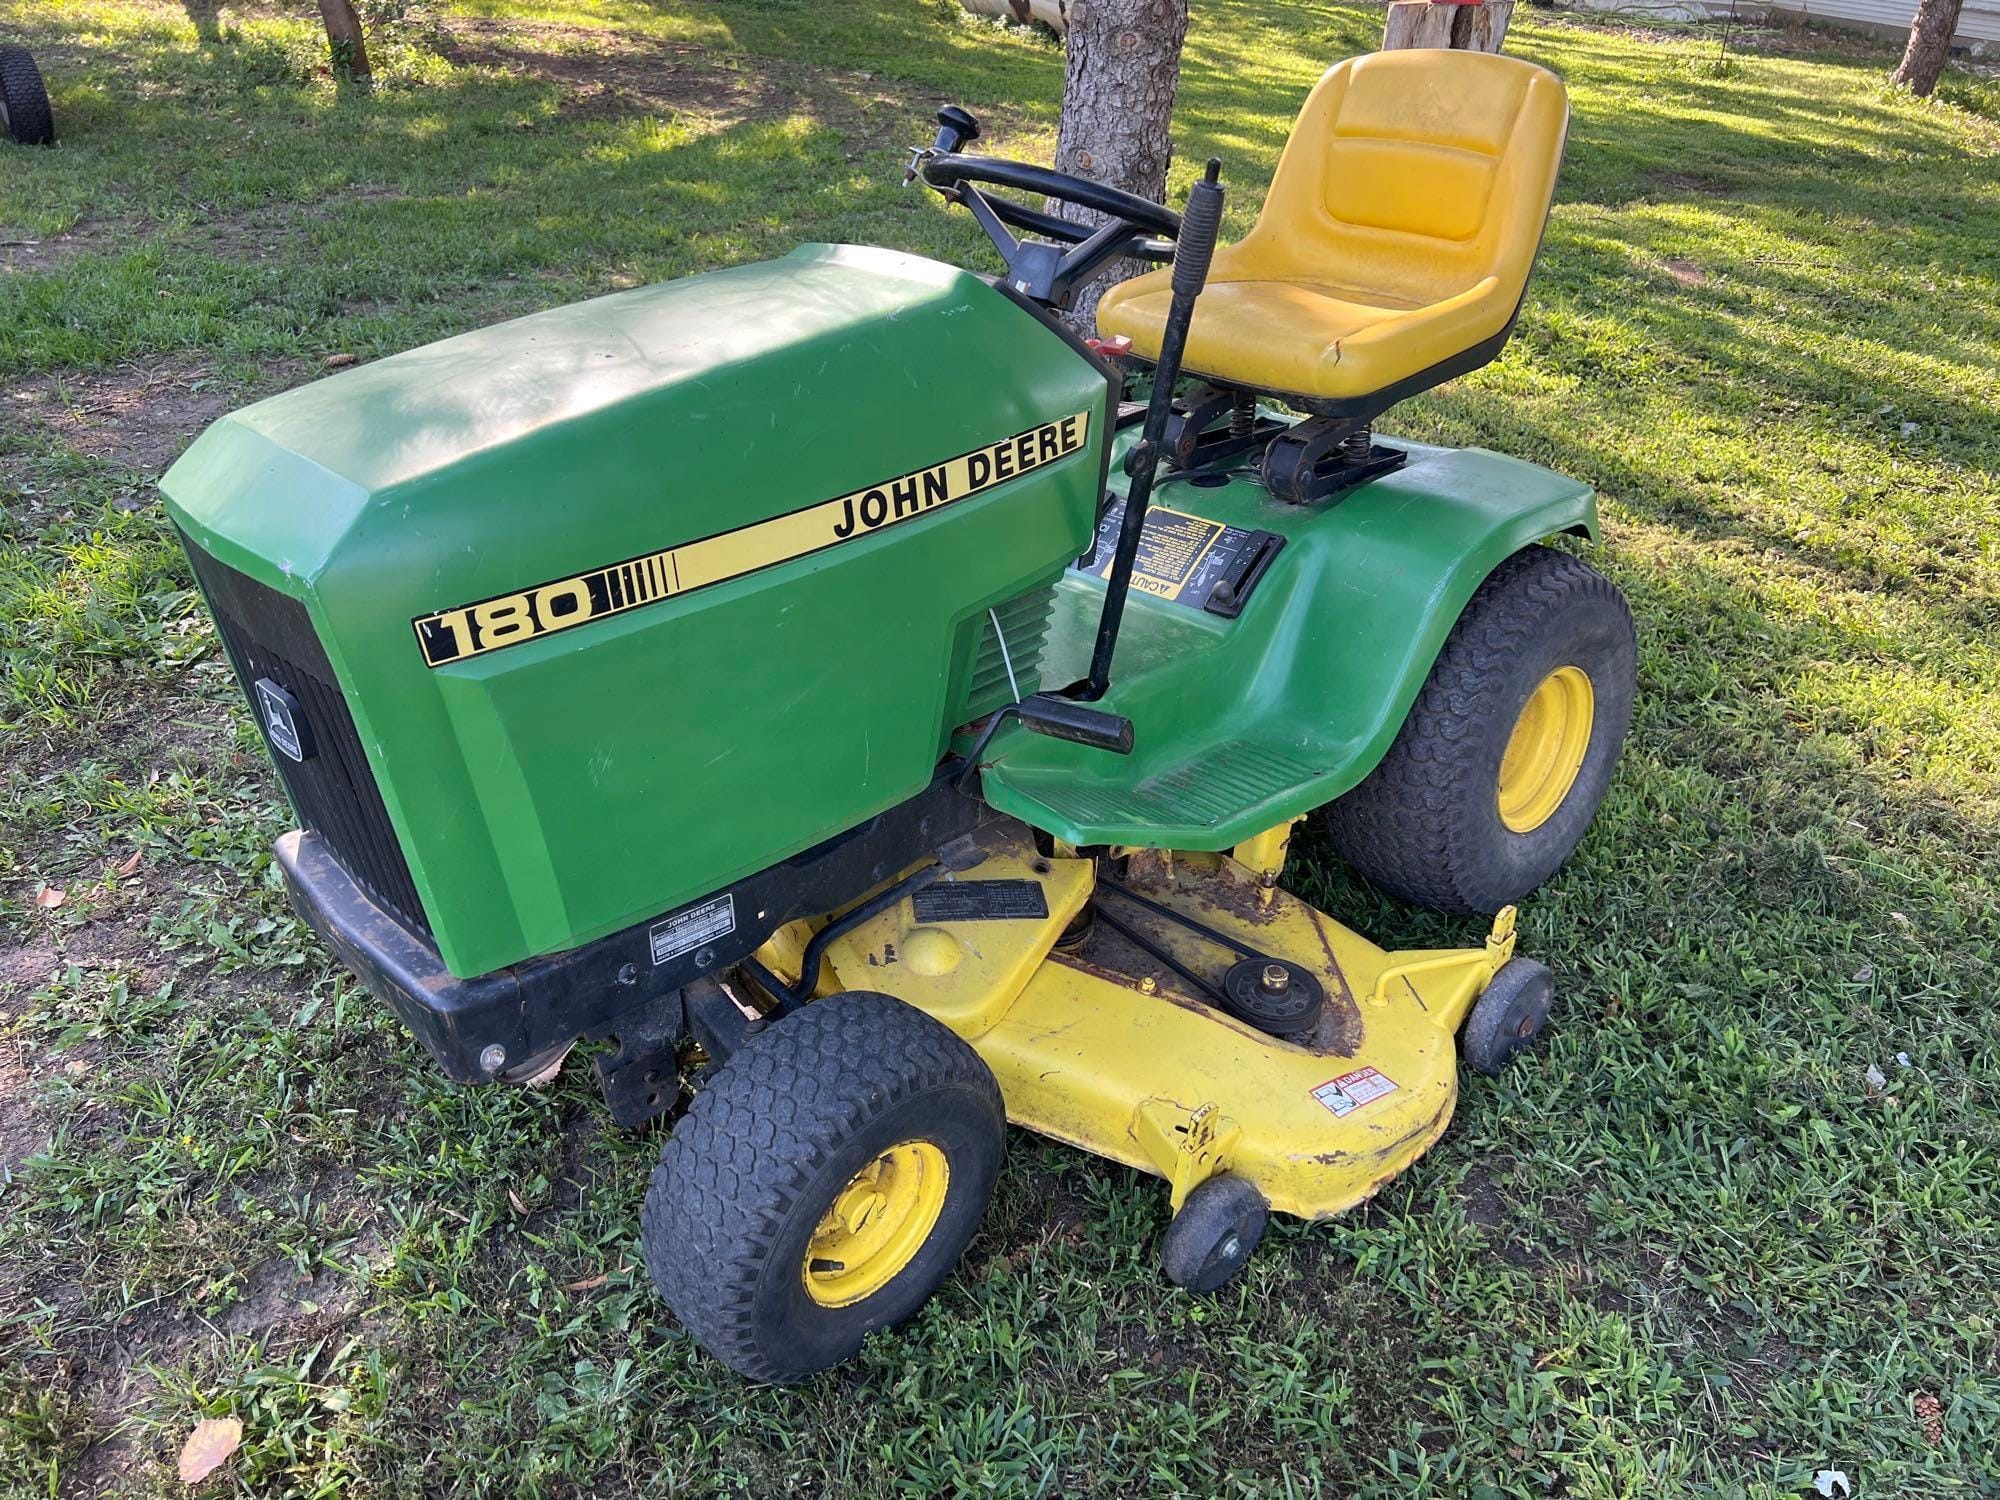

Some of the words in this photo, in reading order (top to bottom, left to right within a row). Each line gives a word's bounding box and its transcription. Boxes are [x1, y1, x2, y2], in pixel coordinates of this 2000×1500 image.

[833, 467, 948, 538] JOHN
[967, 416, 1078, 491] DEERE
[1129, 574, 1160, 590] CAUT
[440, 578, 593, 657] 180
[667, 915, 689, 929] JOHN
[690, 903, 716, 918] DEERE
